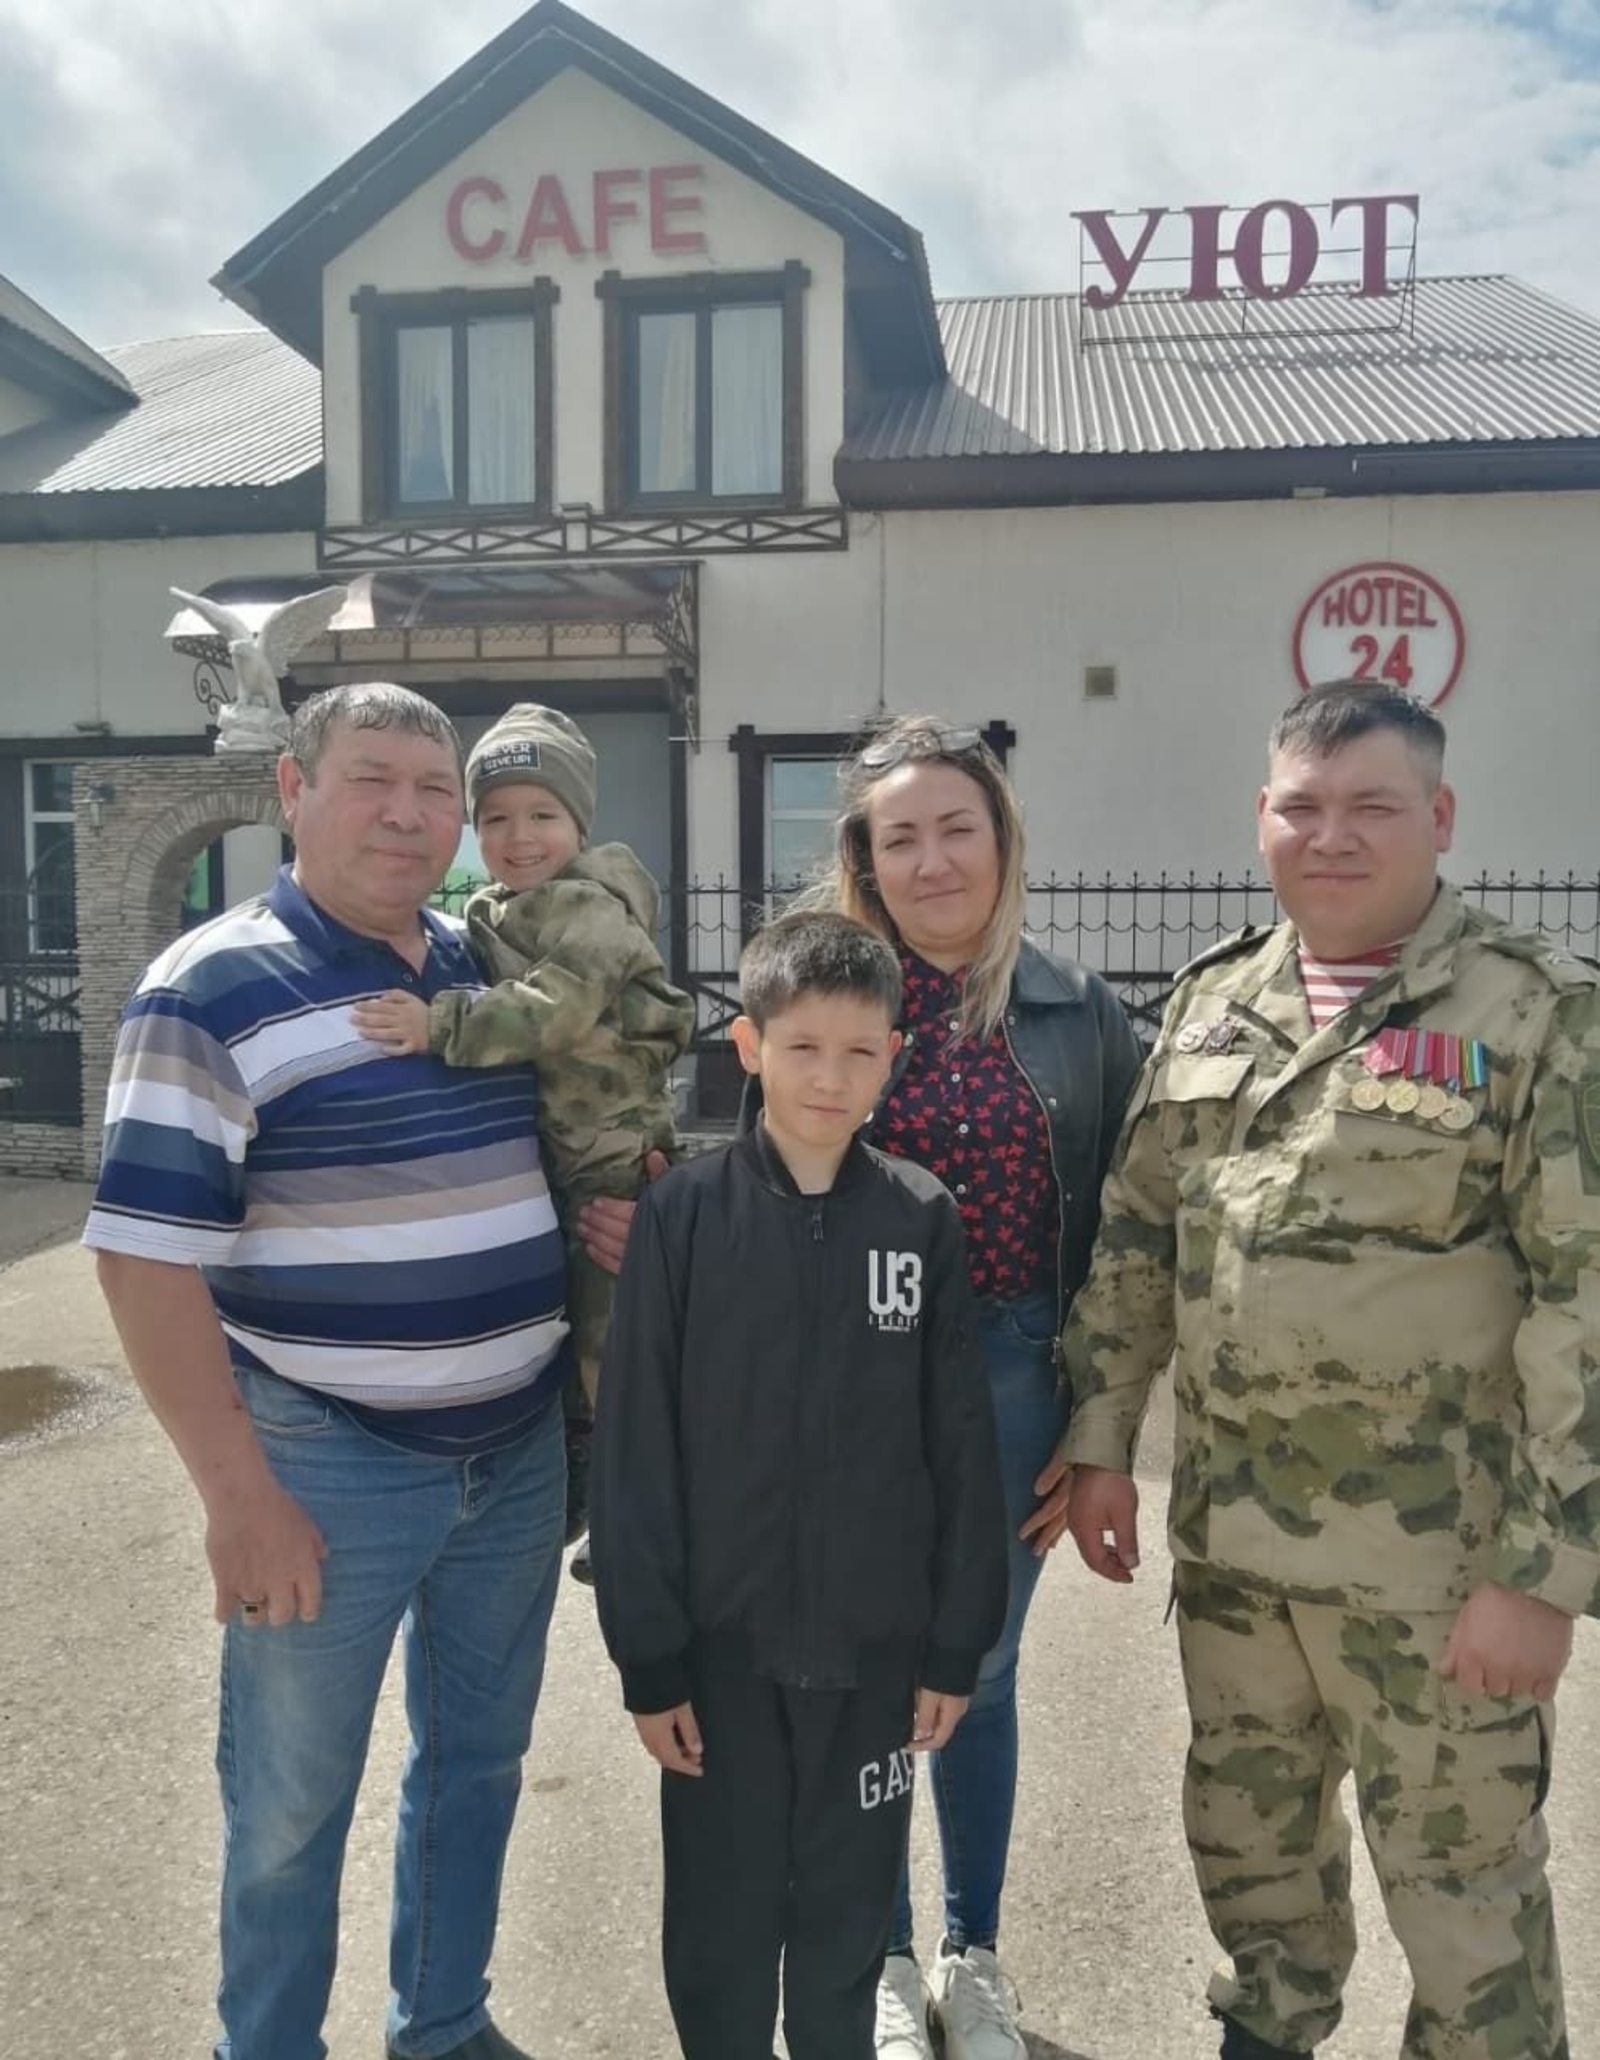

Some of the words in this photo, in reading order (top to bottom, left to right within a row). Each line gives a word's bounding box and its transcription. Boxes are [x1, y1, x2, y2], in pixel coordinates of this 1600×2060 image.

[446, 164, 708, 262] CAFE
[1070, 194, 1420, 309] УЮТ
[1322, 577, 1438, 627] HOTEL
[1350, 634, 1413, 688] 24
[484, 742, 531, 760] EVER
